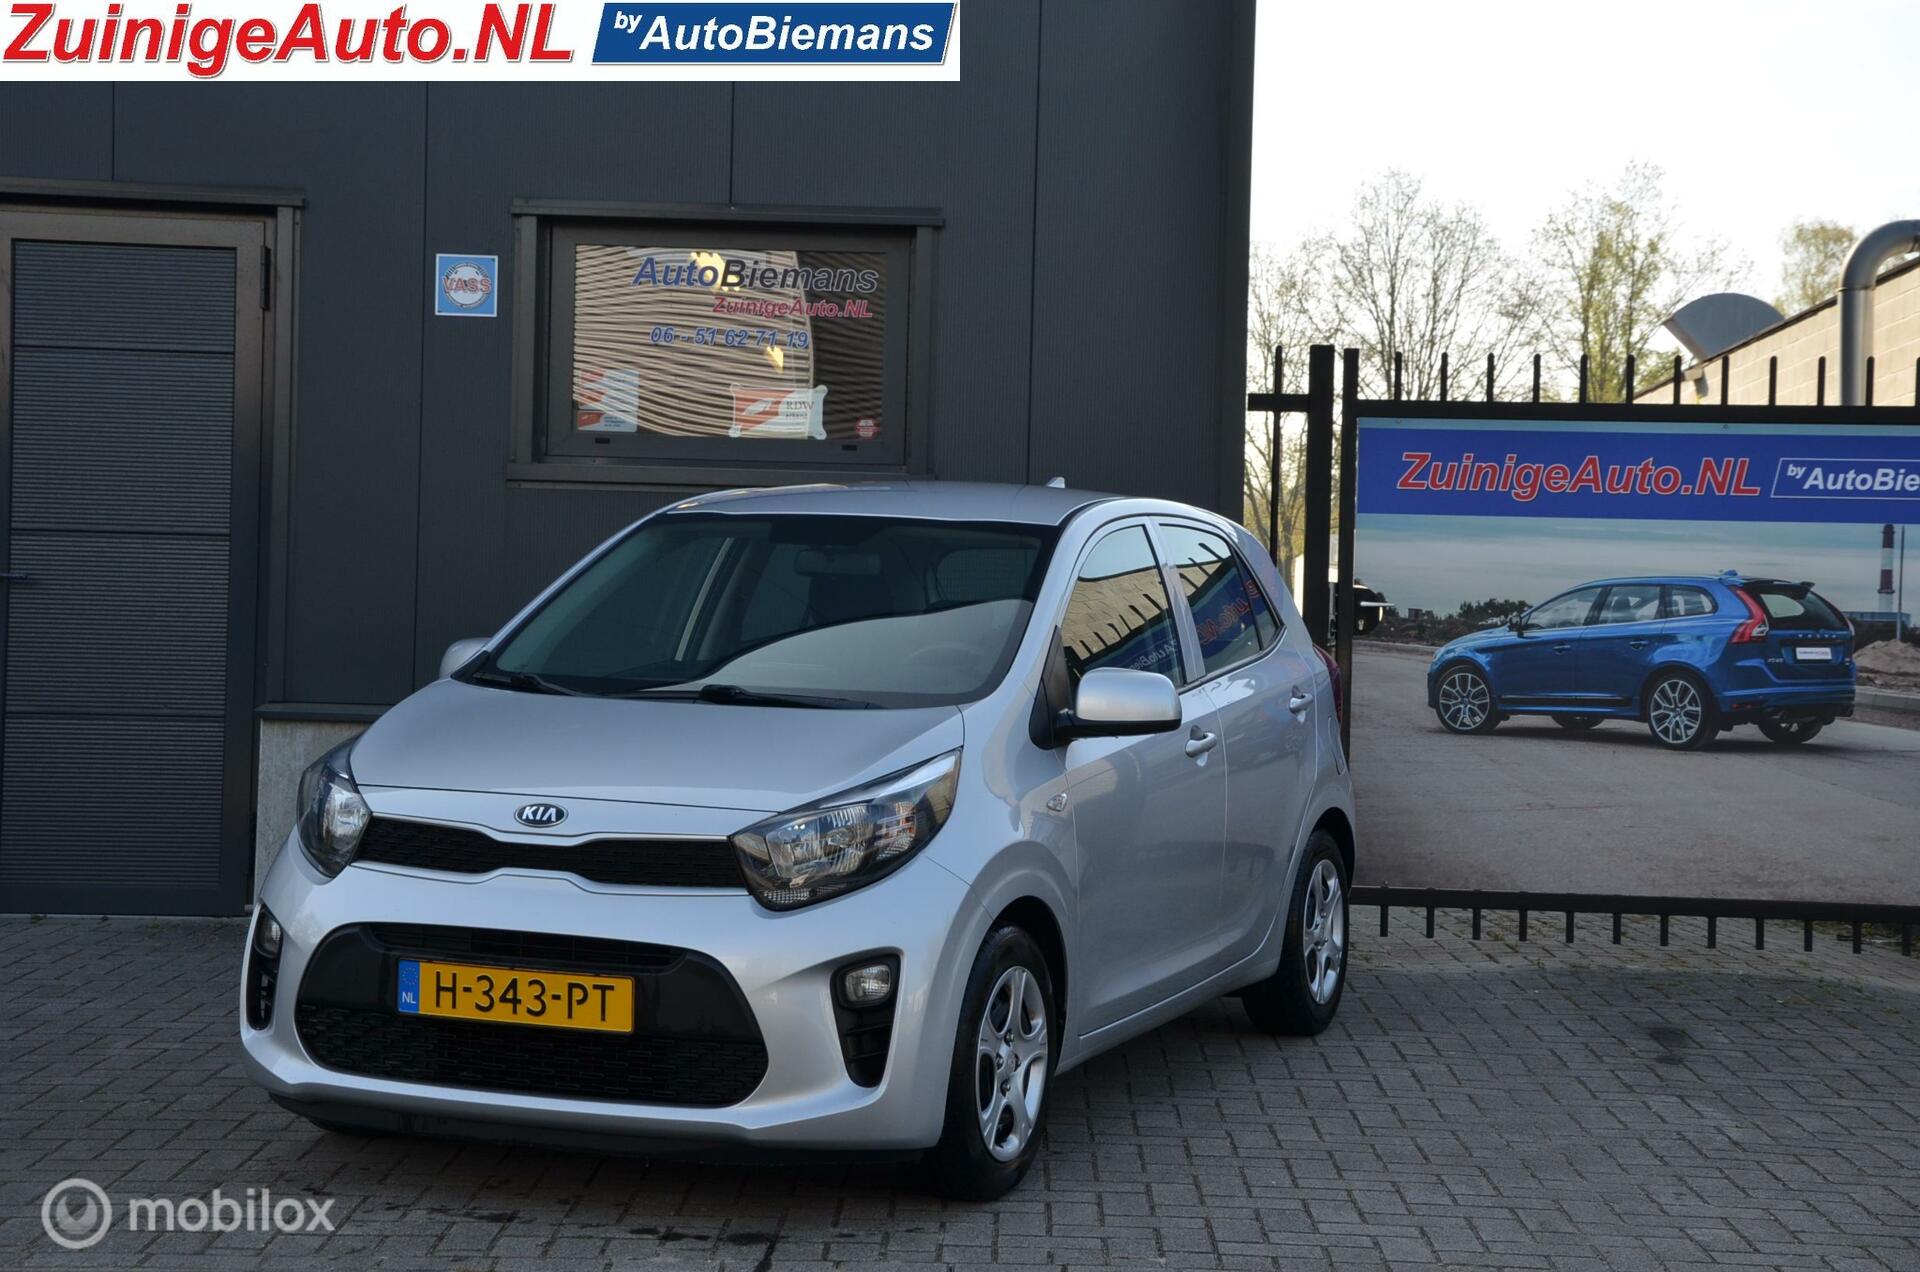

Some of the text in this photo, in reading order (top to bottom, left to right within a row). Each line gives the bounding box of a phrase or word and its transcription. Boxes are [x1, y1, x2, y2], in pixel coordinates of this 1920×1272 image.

[632, 257, 879, 293] AutoBiemans
[712, 297, 873, 319] ZuinigeAuto.NL
[651, 327, 674, 343] 06
[695, 328, 717, 345] 51
[725, 329, 748, 346] 62
[756, 330, 777, 346] 71
[786, 331, 809, 348] 19
[1397, 452, 1760, 501] ZuinigeAuto.NL
[1786, 463, 1807, 479] by
[522, 805, 556, 821] KIA
[402, 991, 416, 1005] NL
[435, 971, 615, 1022] H-343-PT
